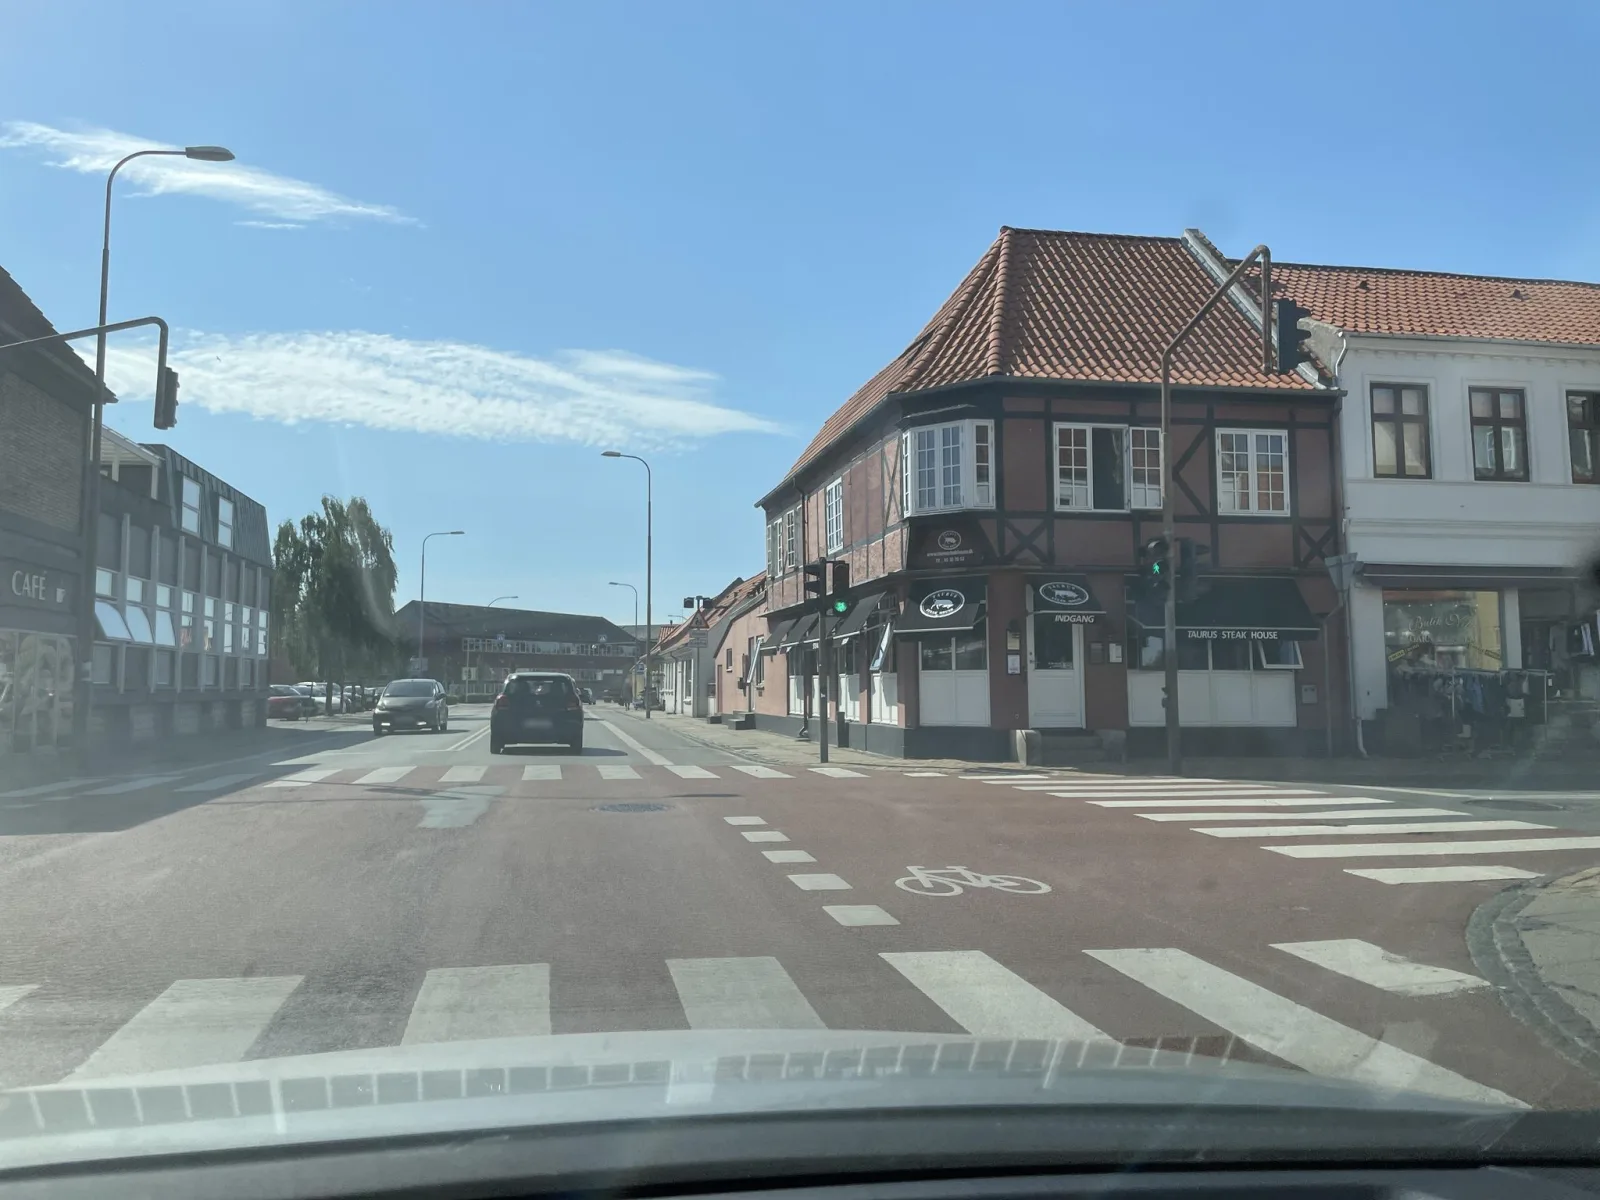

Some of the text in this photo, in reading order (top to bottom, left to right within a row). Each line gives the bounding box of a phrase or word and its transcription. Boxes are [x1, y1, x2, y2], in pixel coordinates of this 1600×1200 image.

[11, 569, 47, 601] CAFÉ
[1054, 614, 1095, 623] INDGANG
[1187, 630, 1278, 639] TAURUS STEAK HOUSE
